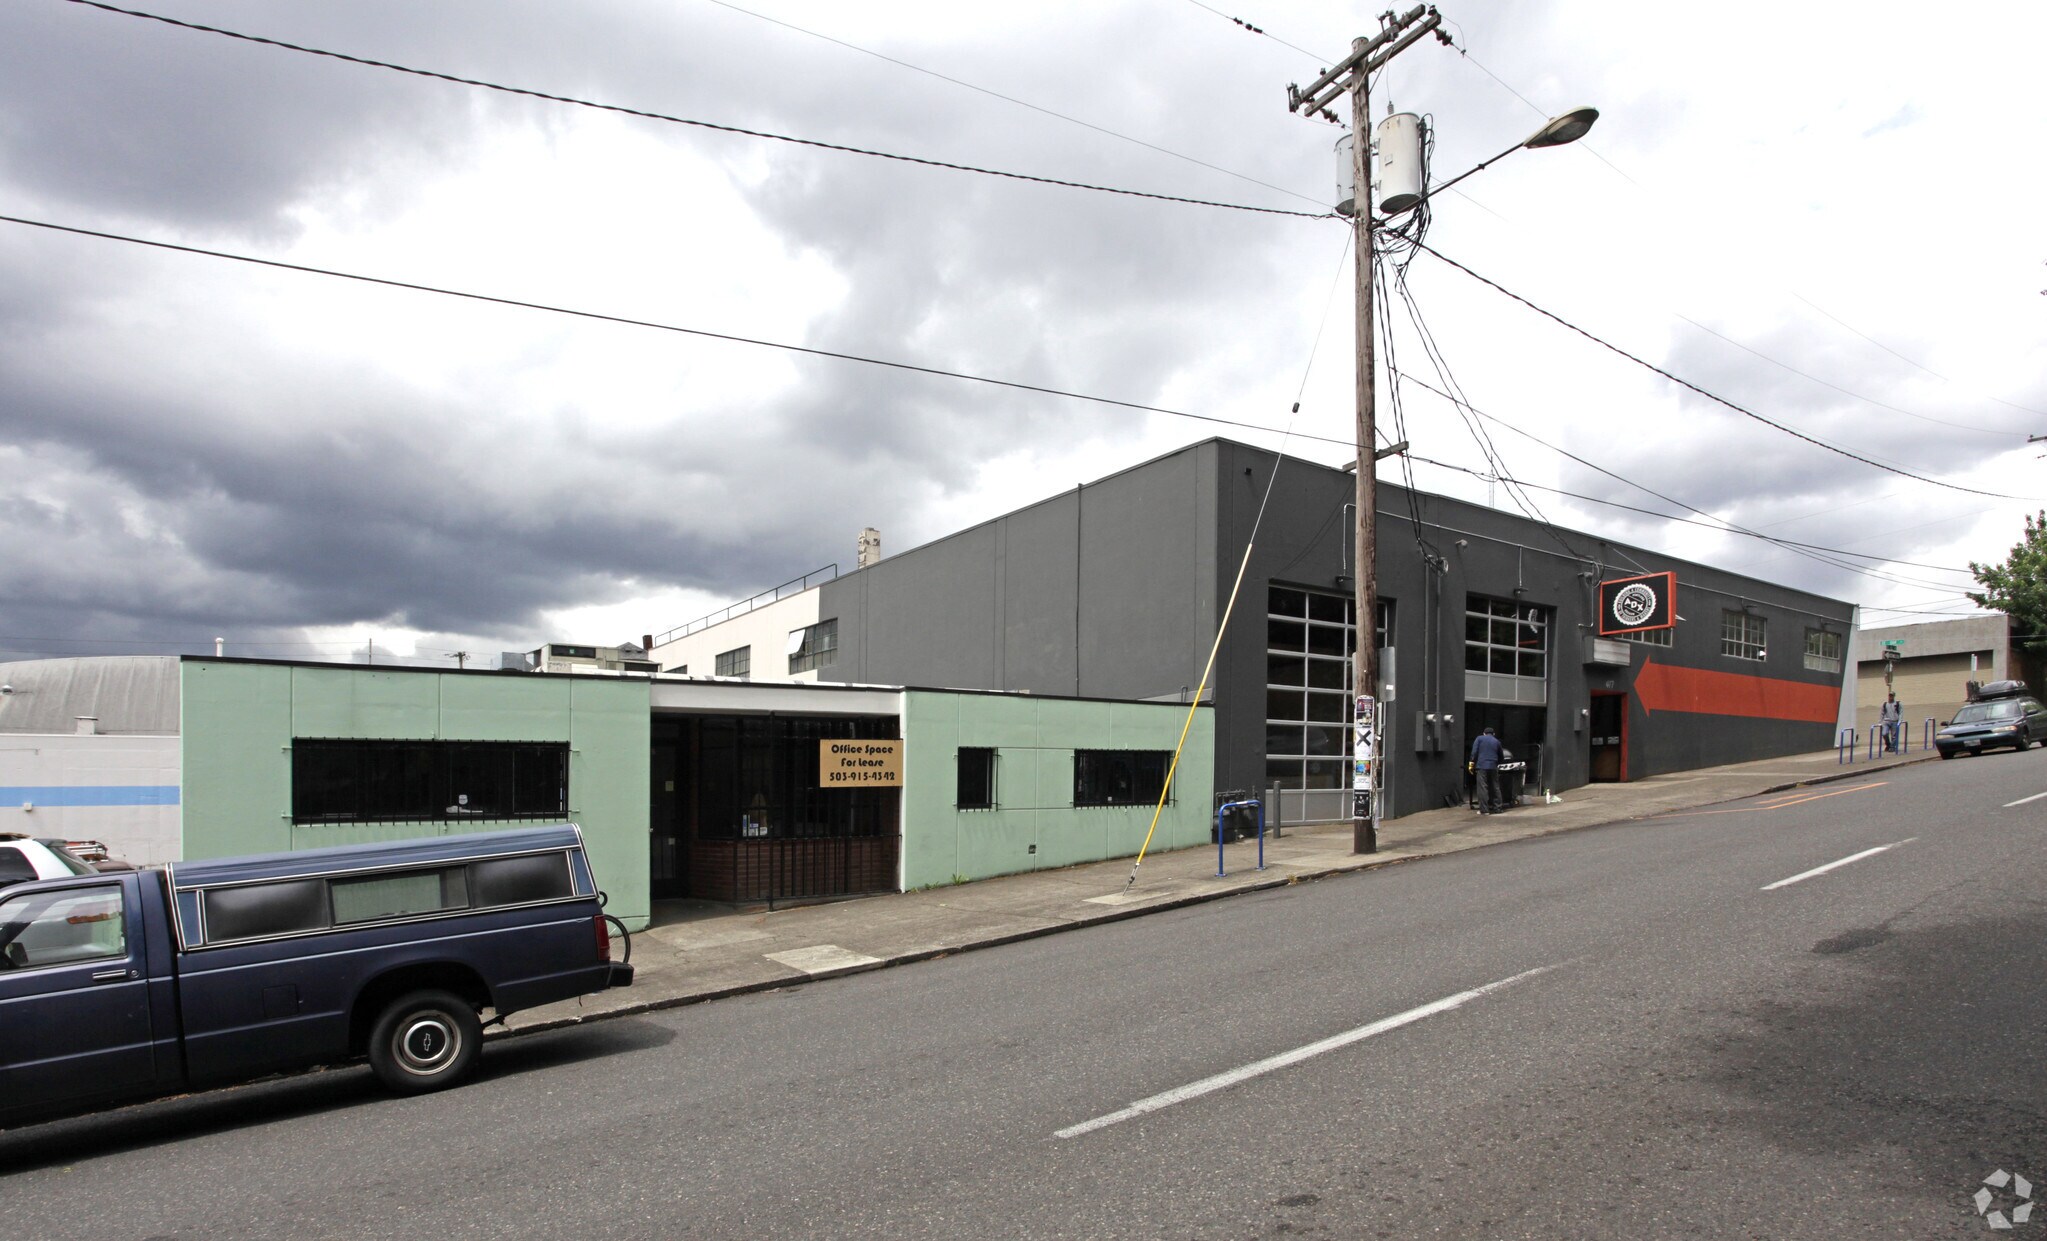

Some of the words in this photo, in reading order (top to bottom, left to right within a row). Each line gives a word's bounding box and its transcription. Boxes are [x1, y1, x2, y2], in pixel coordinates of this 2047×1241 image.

[1624, 597, 1644, 611] ADX
[831, 744, 862, 754] Office
[864, 744, 894, 755] Space
[841, 758, 856, 767] For
[829, 771, 895, 781] 503-915-4342
